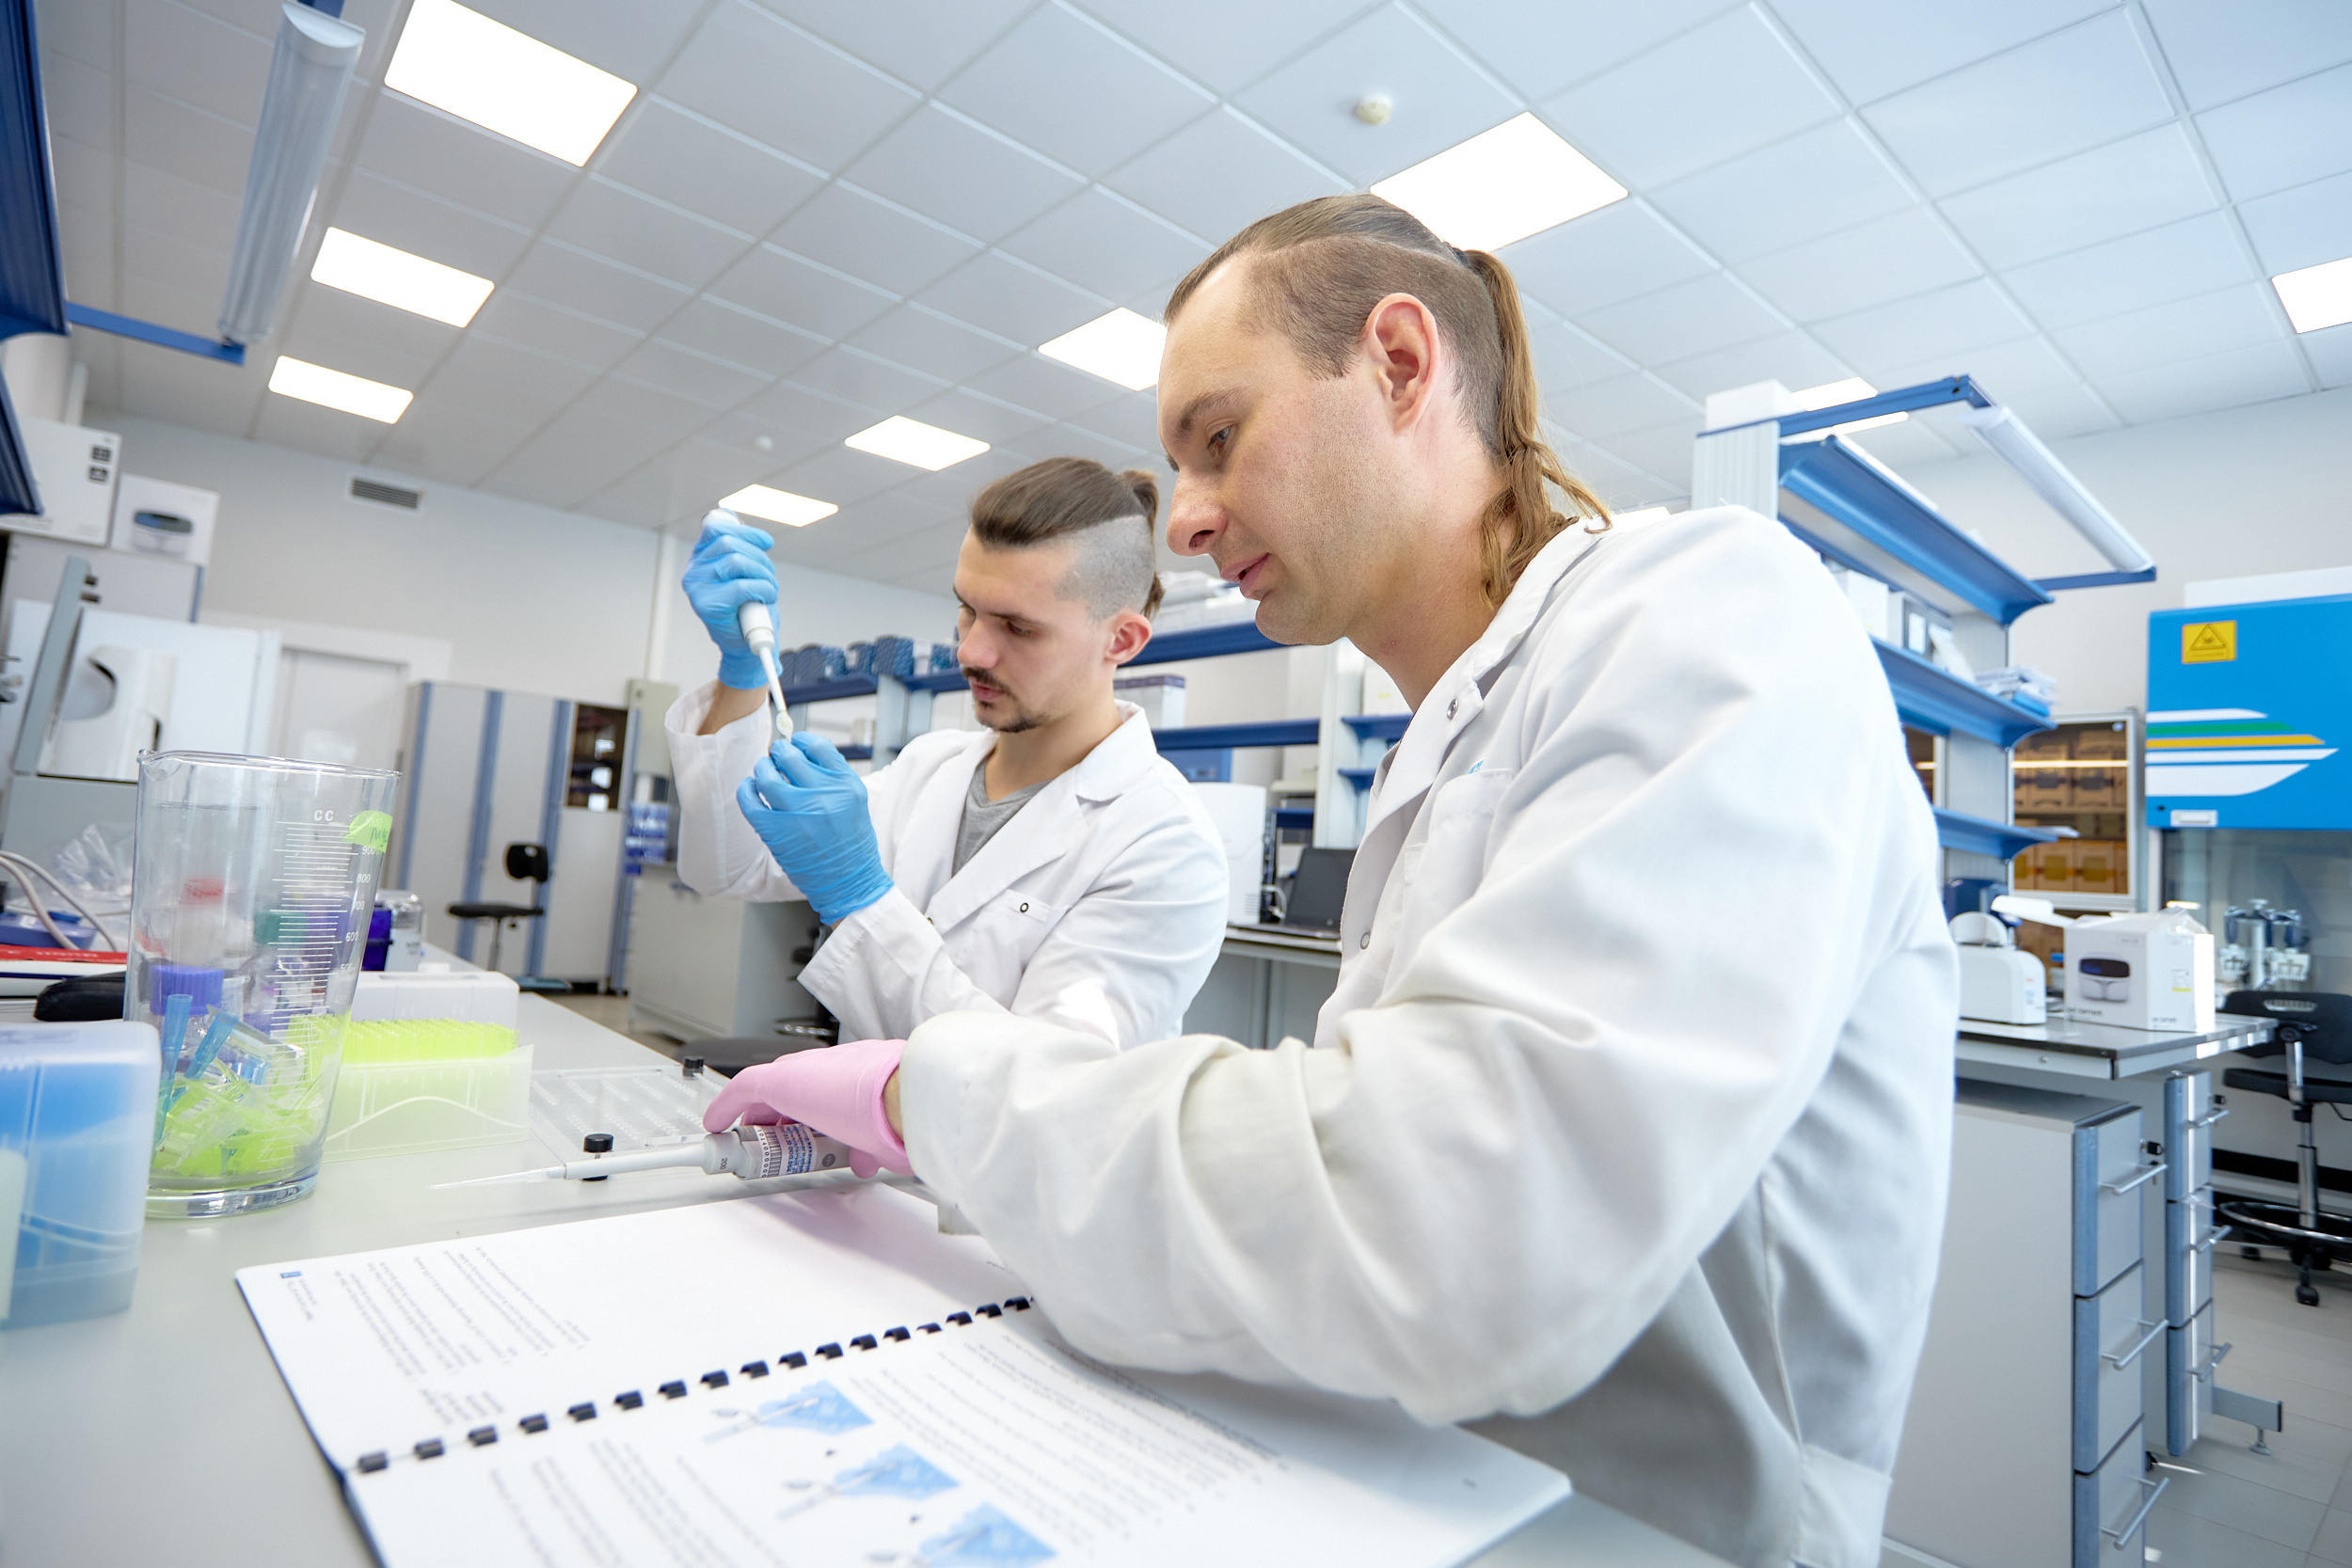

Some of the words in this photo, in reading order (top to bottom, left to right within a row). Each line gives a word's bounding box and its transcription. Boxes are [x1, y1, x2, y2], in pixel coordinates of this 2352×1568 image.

[362, 846, 376, 855] 900
[357, 873, 371, 883] 800
[345, 931, 358, 942] 600
